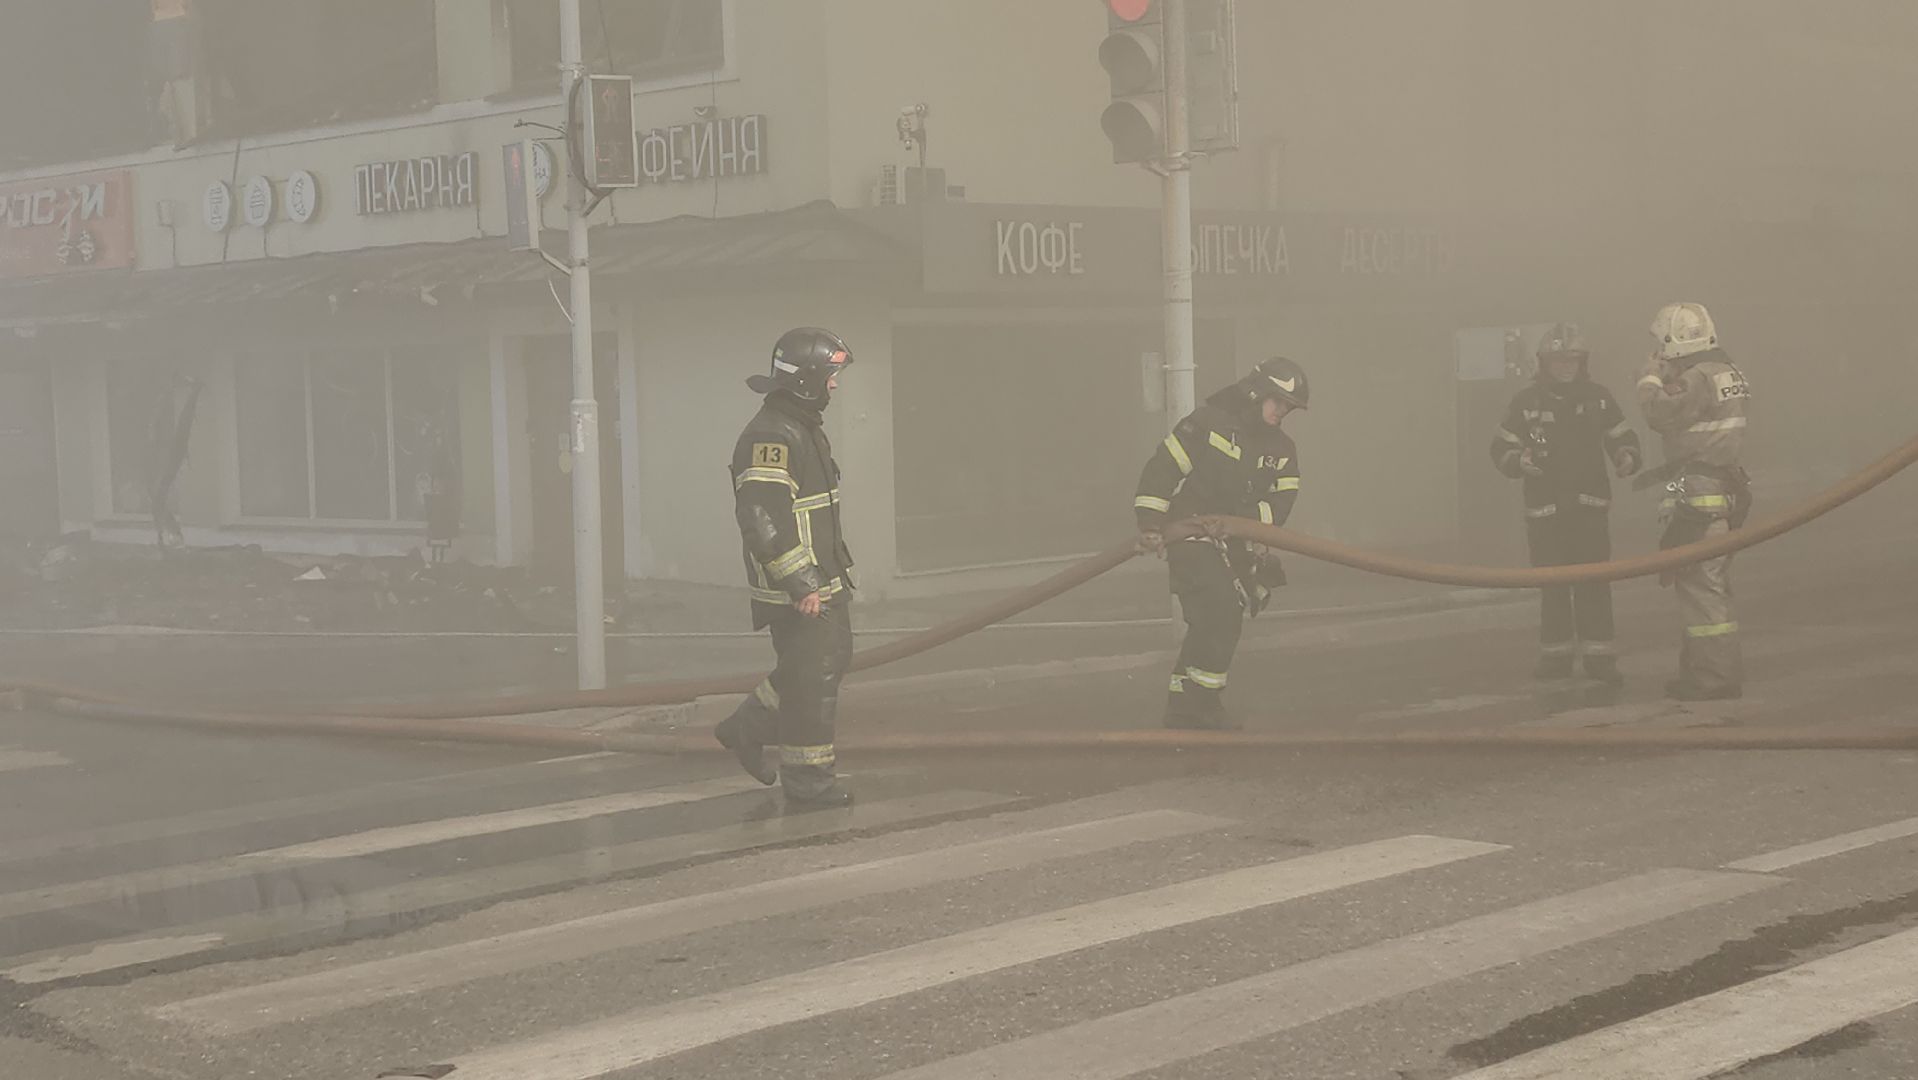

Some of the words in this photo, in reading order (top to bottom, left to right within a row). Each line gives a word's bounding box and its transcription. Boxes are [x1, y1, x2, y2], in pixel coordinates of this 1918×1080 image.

[642, 107, 760, 183] ФЕЙНЯ
[355, 152, 472, 214] ПЕКАРНЯ
[997, 220, 1085, 274] КОФЕ
[759, 446, 782, 463] 13
